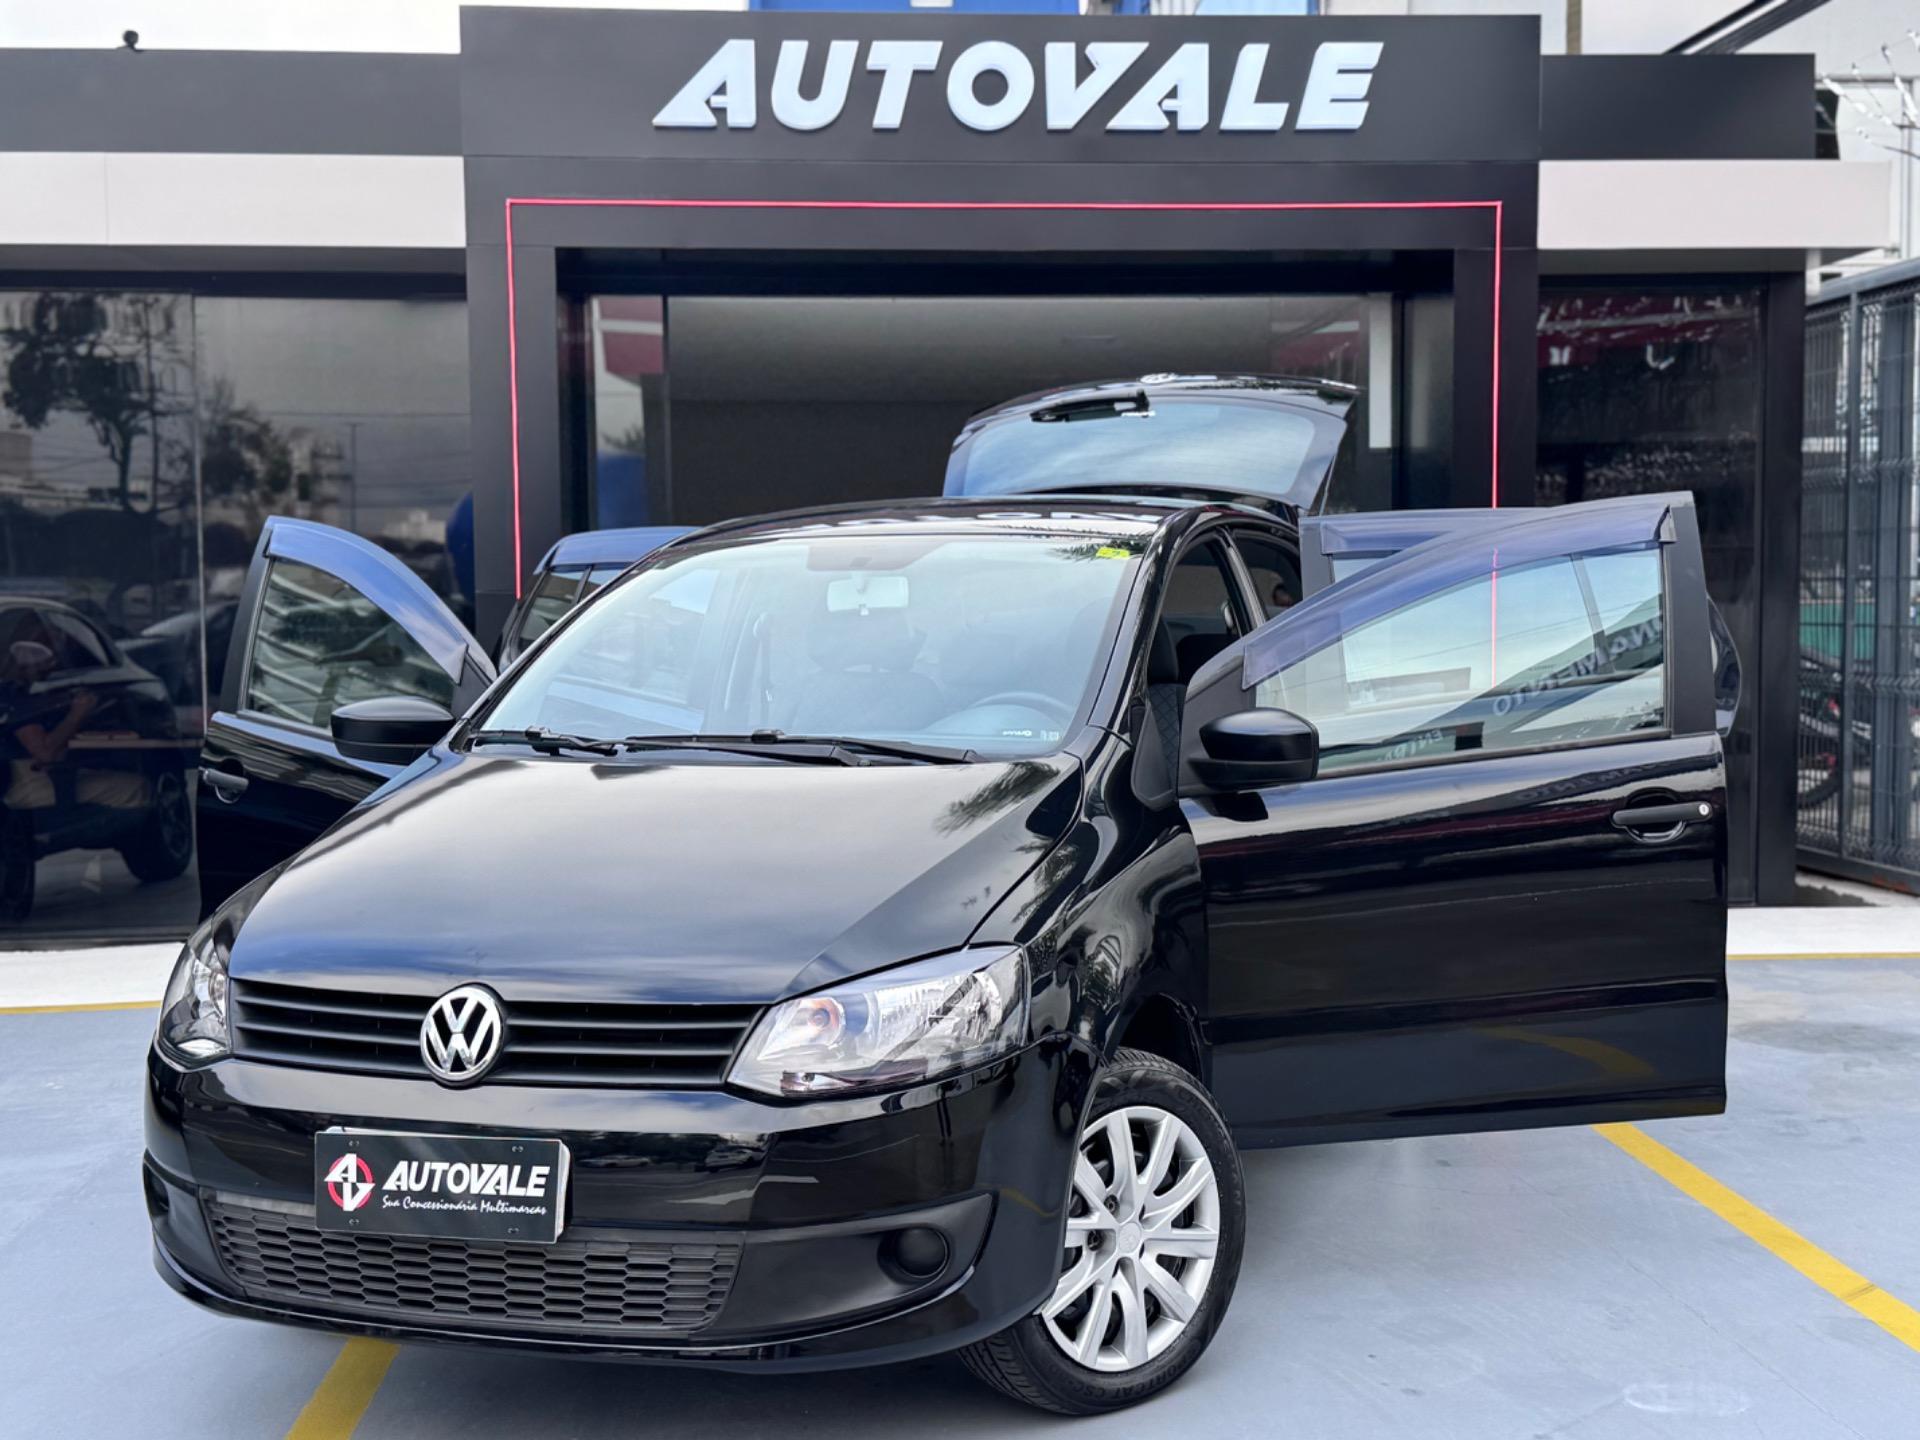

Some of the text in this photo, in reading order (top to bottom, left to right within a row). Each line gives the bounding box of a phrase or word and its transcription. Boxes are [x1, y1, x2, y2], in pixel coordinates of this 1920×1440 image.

[652, 39, 1385, 132] AUTOVALE
[382, 1160, 550, 1197] AUTOVALE
[382, 1195, 400, 1209] Sua
[480, 1200, 547, 1216] Multimarcas
